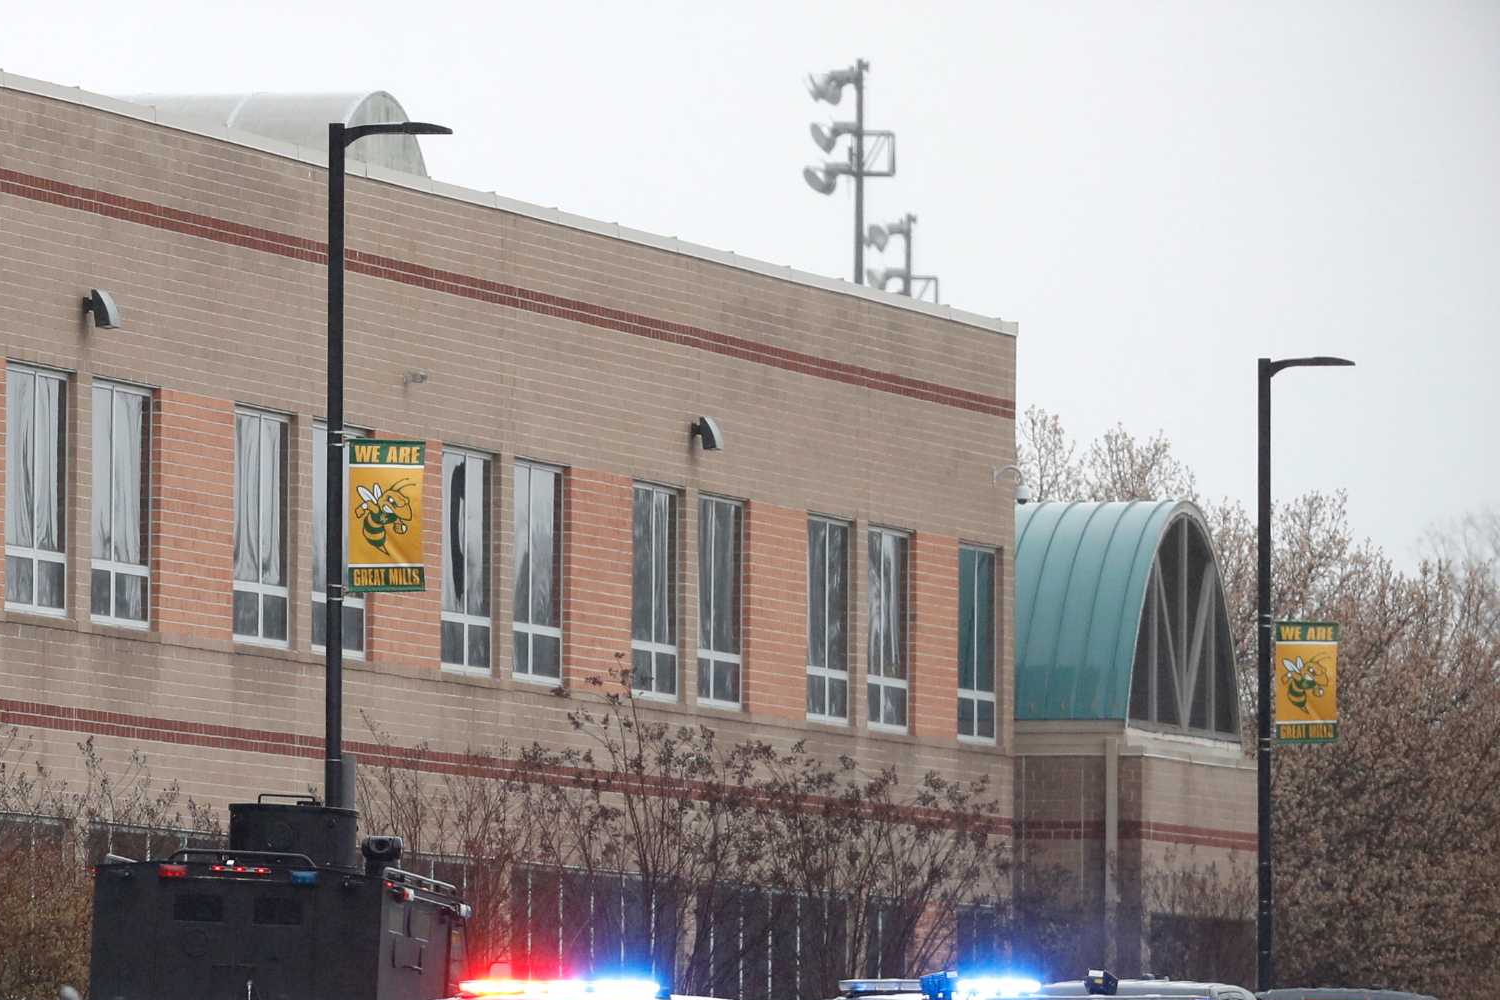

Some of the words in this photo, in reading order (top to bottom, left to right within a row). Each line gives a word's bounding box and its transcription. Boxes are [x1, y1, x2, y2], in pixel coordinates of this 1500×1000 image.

[355, 445, 380, 463] WE
[386, 446, 420, 464] ARE
[353, 569, 385, 587] GREAT
[389, 568, 420, 586] MILLS
[1280, 626, 1301, 640] WE
[1306, 626, 1333, 640] ARE
